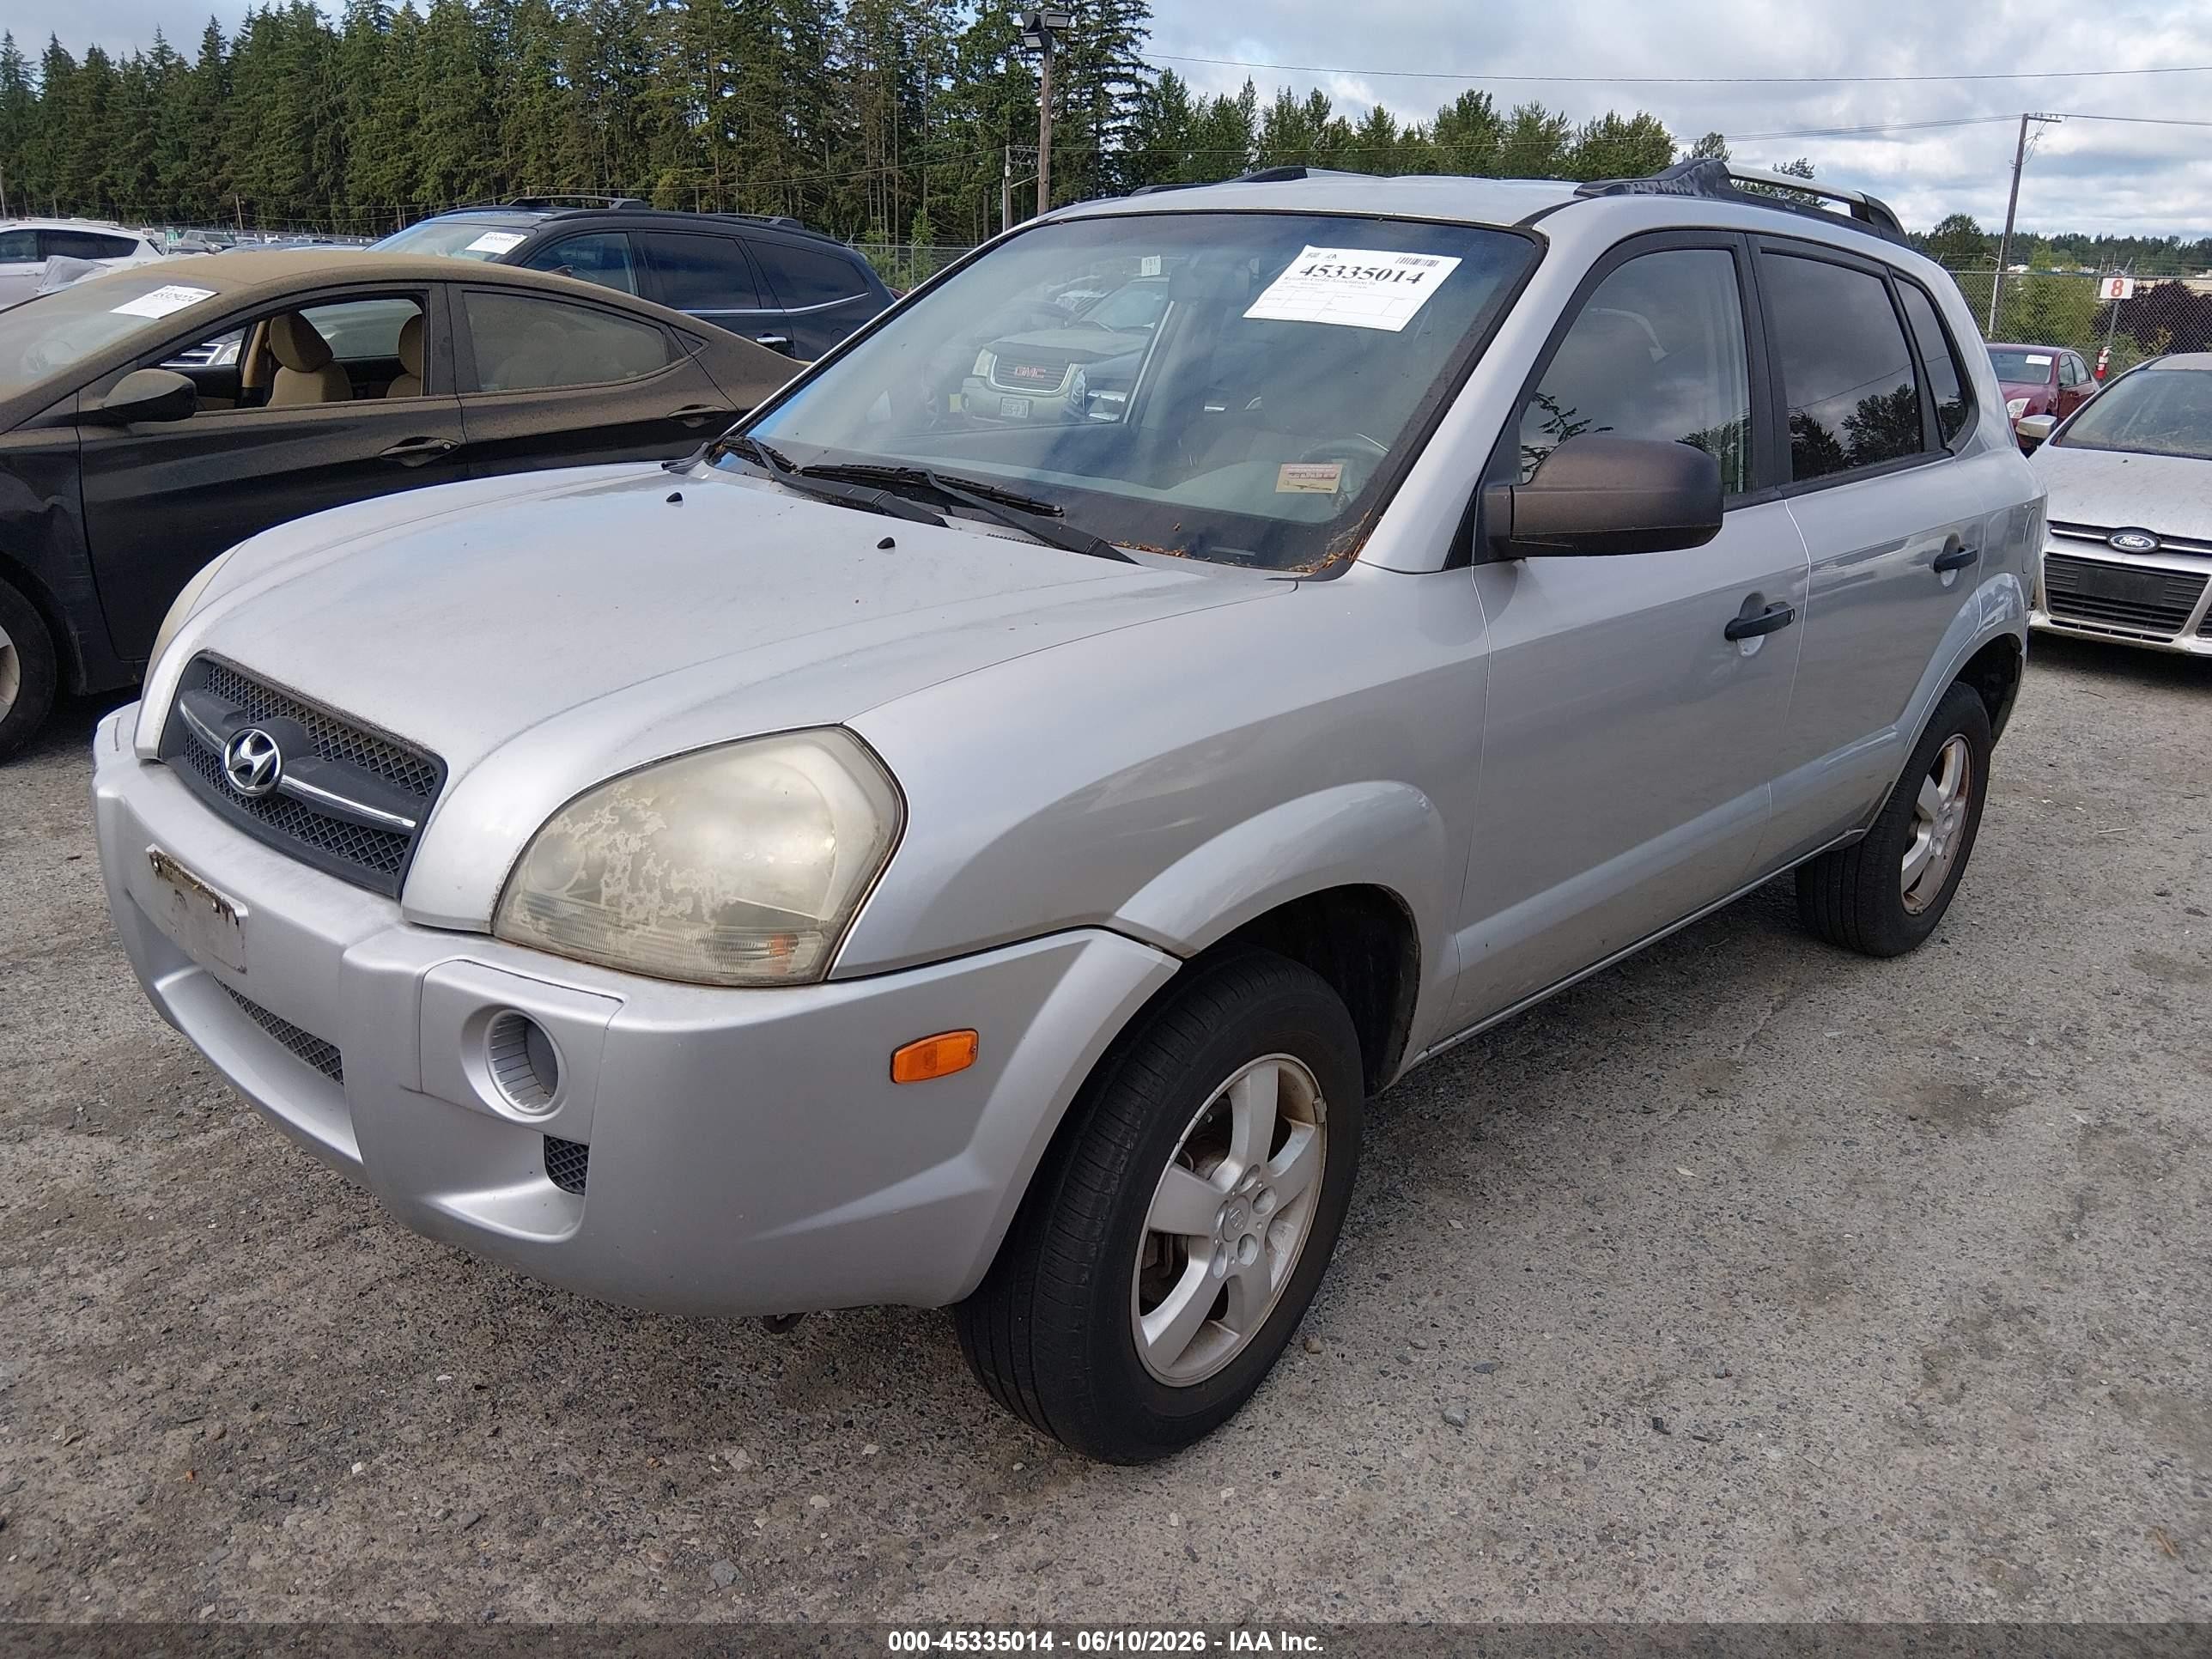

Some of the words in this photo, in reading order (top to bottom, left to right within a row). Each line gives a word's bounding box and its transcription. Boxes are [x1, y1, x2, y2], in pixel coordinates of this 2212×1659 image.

[1299, 264, 1425, 284] 45335014
[2110, 279, 2124, 297] 8
[1015, 366, 1046, 379] GMC
[2118, 536, 2145, 547] Ford
